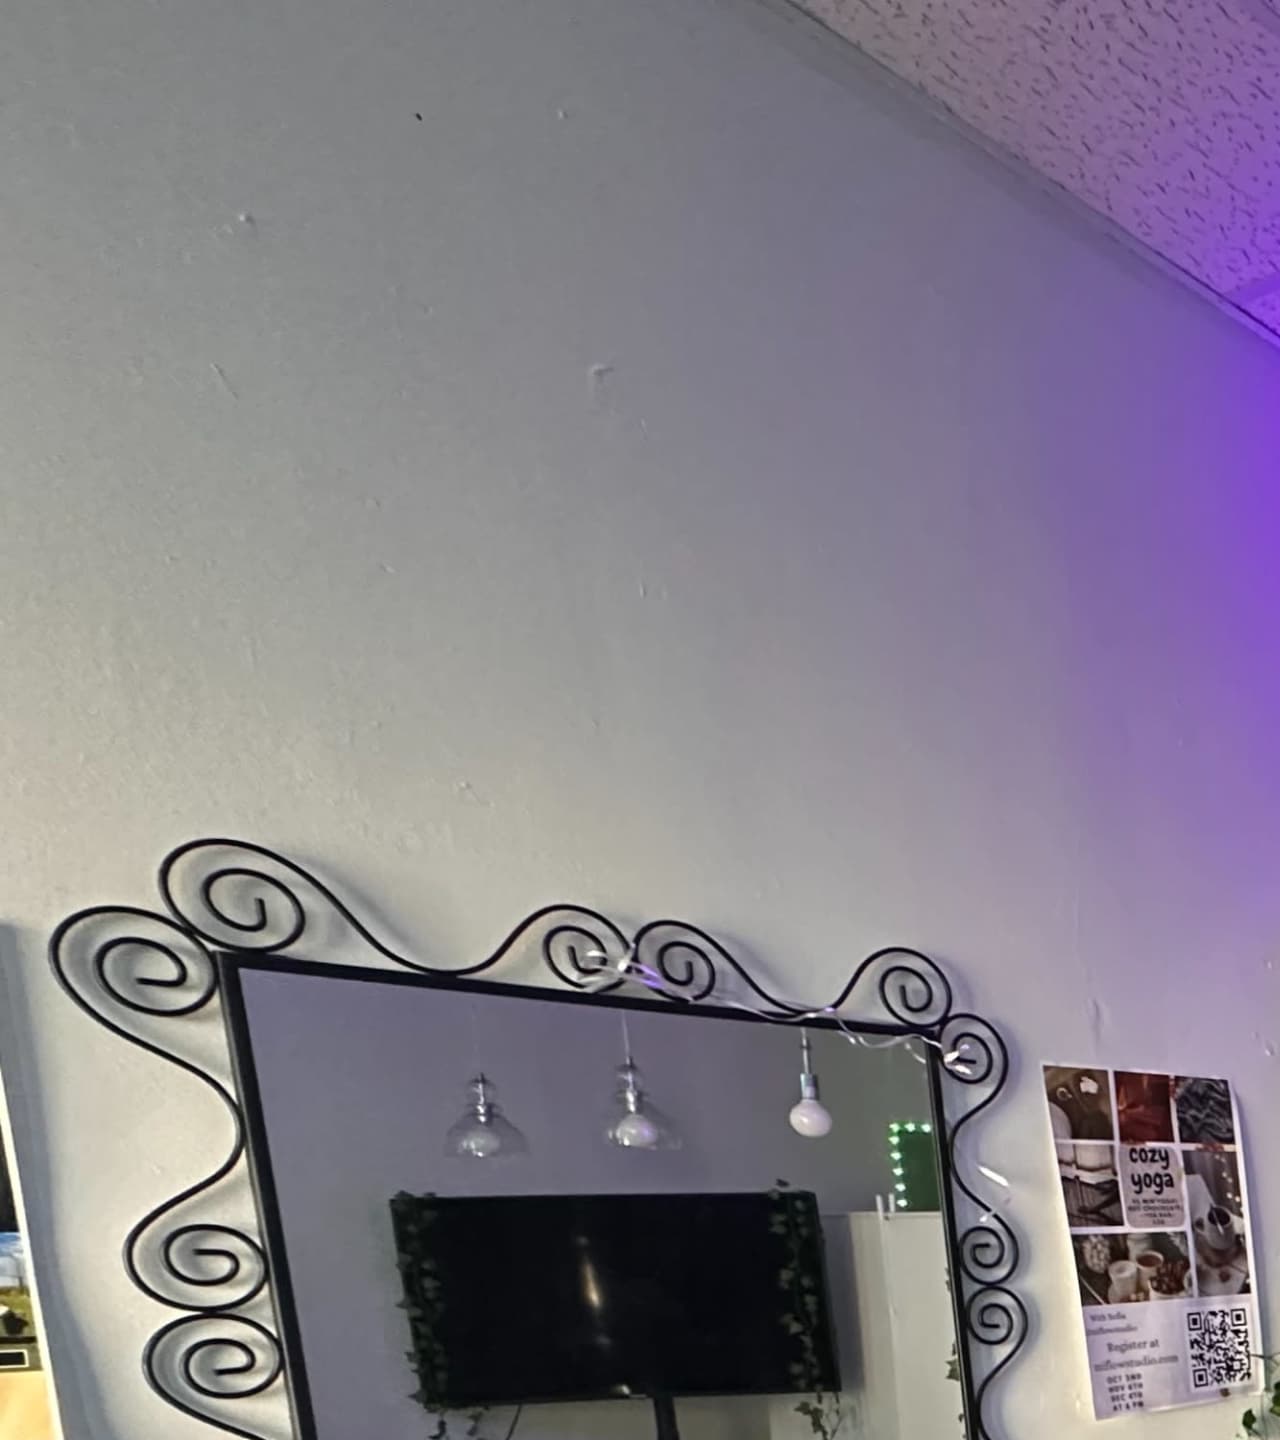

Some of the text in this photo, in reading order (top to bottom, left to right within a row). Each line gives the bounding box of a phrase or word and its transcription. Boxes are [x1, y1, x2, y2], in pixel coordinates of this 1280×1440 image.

[1129, 1147, 1171, 1171] cozy
[1130, 1172, 1175, 1195] yoga
[1106, 1339, 1160, 1354] Register at
